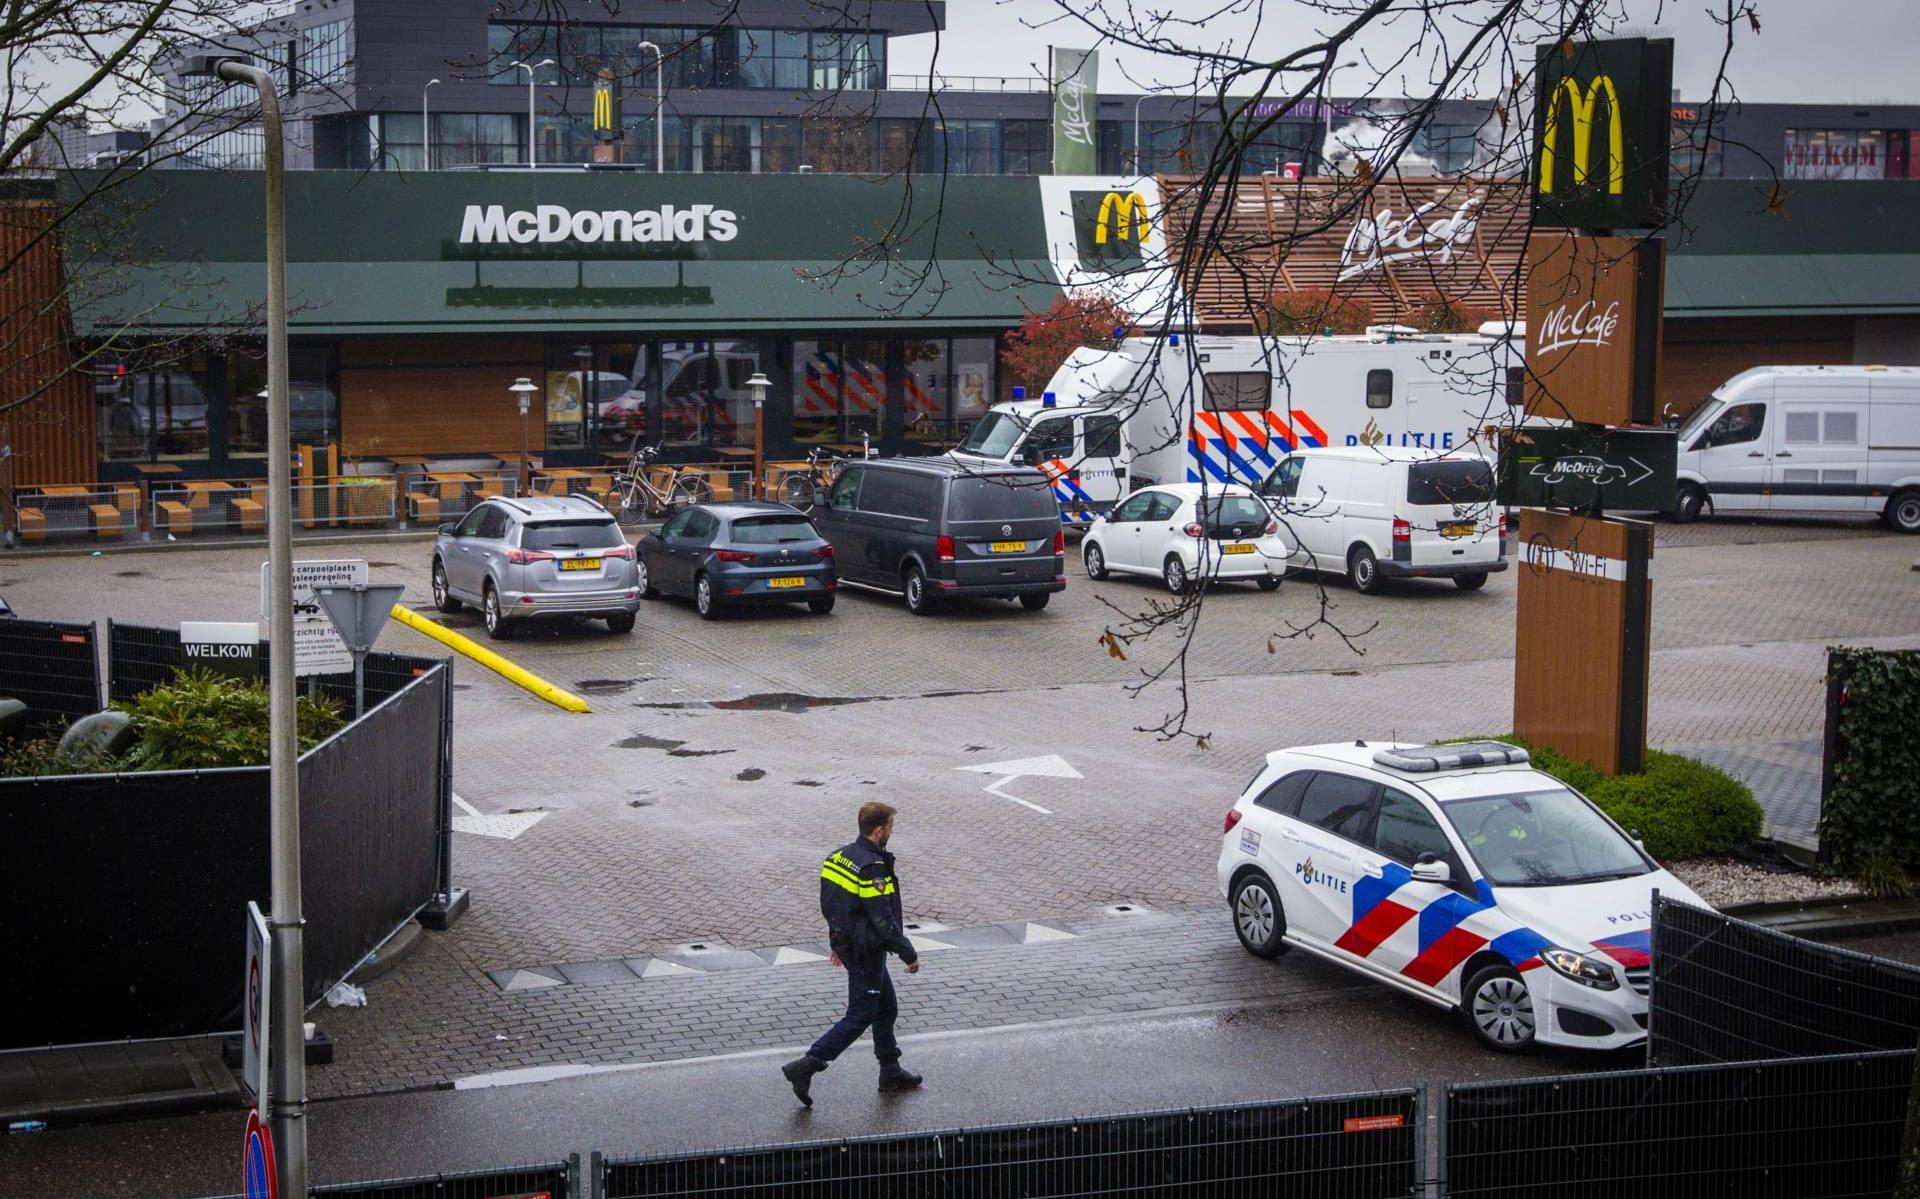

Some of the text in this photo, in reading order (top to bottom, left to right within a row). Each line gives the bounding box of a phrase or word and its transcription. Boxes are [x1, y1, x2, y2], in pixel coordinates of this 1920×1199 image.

[459, 204, 738, 243] McDonald's
[1537, 300, 1619, 353] McCafé
[1552, 461, 1604, 475] McDrive
[297, 565, 357, 575] carpoolplaats
[185, 644, 253, 659] WELKOM
[1296, 861, 1347, 894] POLITIE
[1608, 911, 1650, 925] POLI
